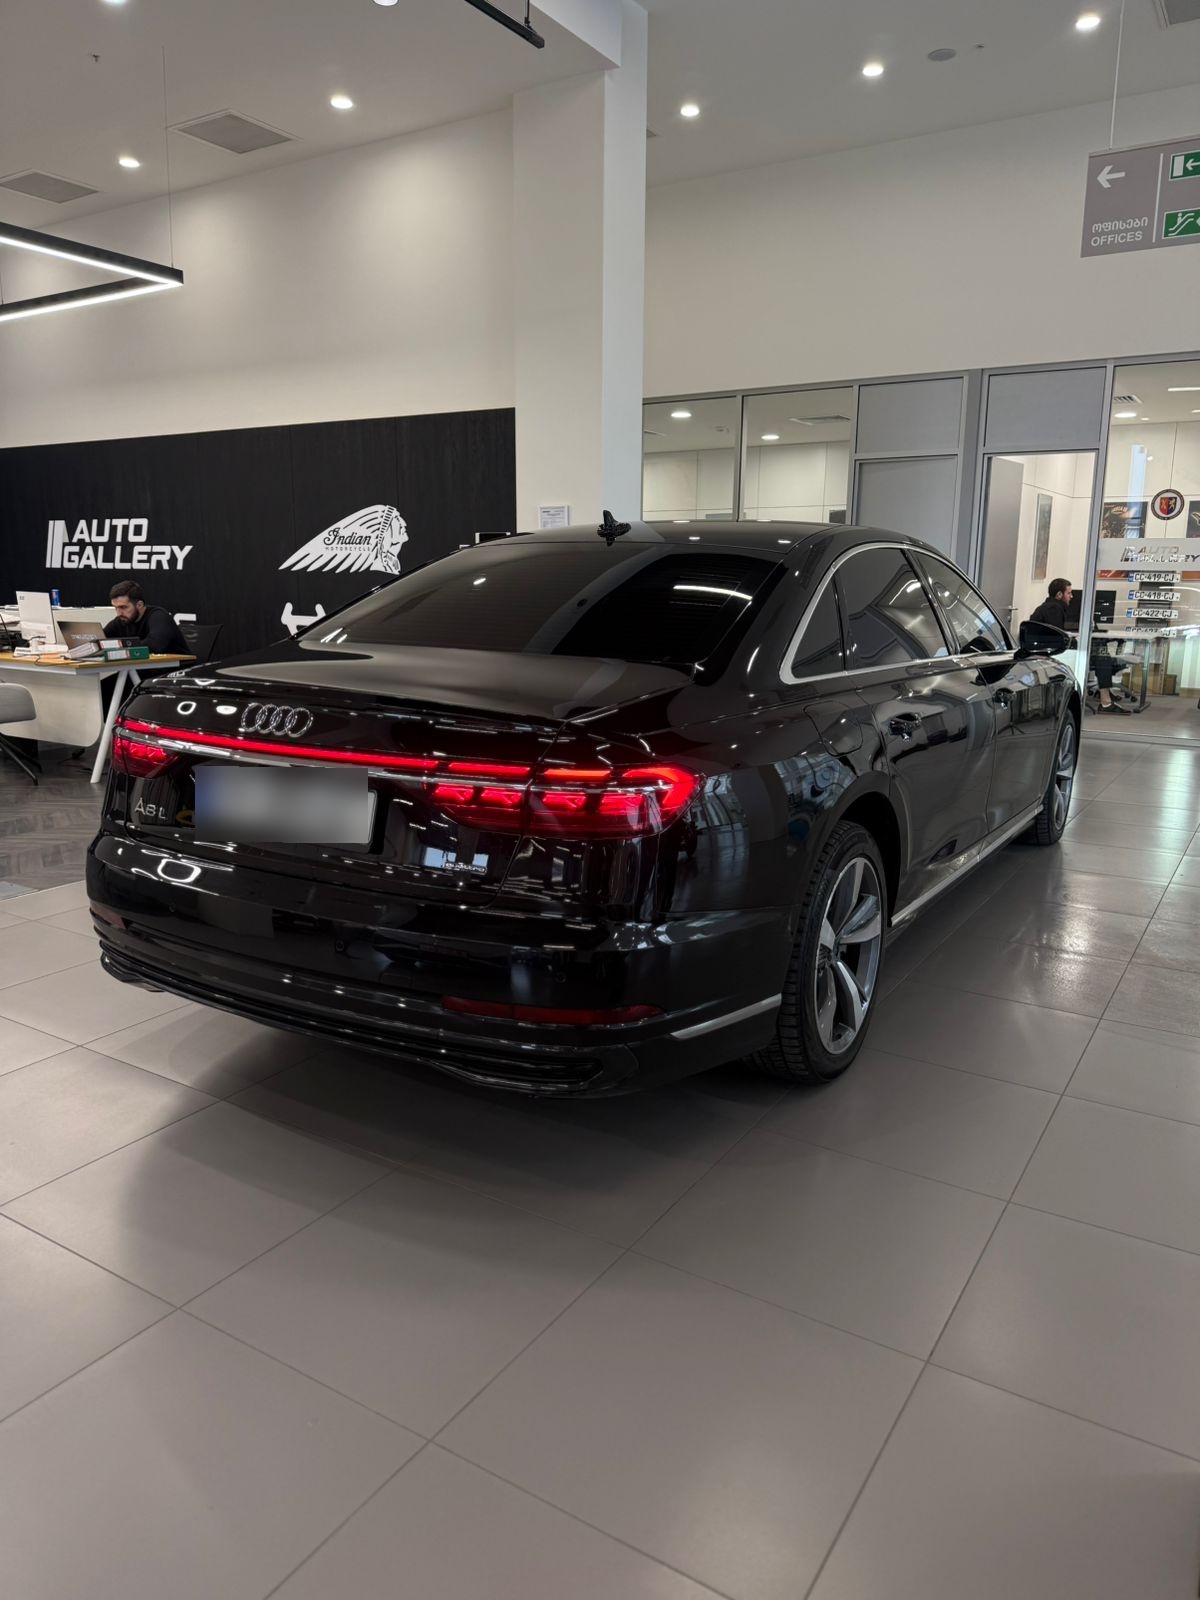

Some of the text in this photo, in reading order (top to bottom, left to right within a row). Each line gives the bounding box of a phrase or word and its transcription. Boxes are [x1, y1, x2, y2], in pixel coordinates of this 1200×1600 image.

[1092, 217, 1148, 233] ოფისები
[1091, 231, 1143, 246] OFFICES
[72, 518, 148, 542] AUTO
[323, 527, 372, 546] Indian
[63, 545, 193, 570] GALLERY
